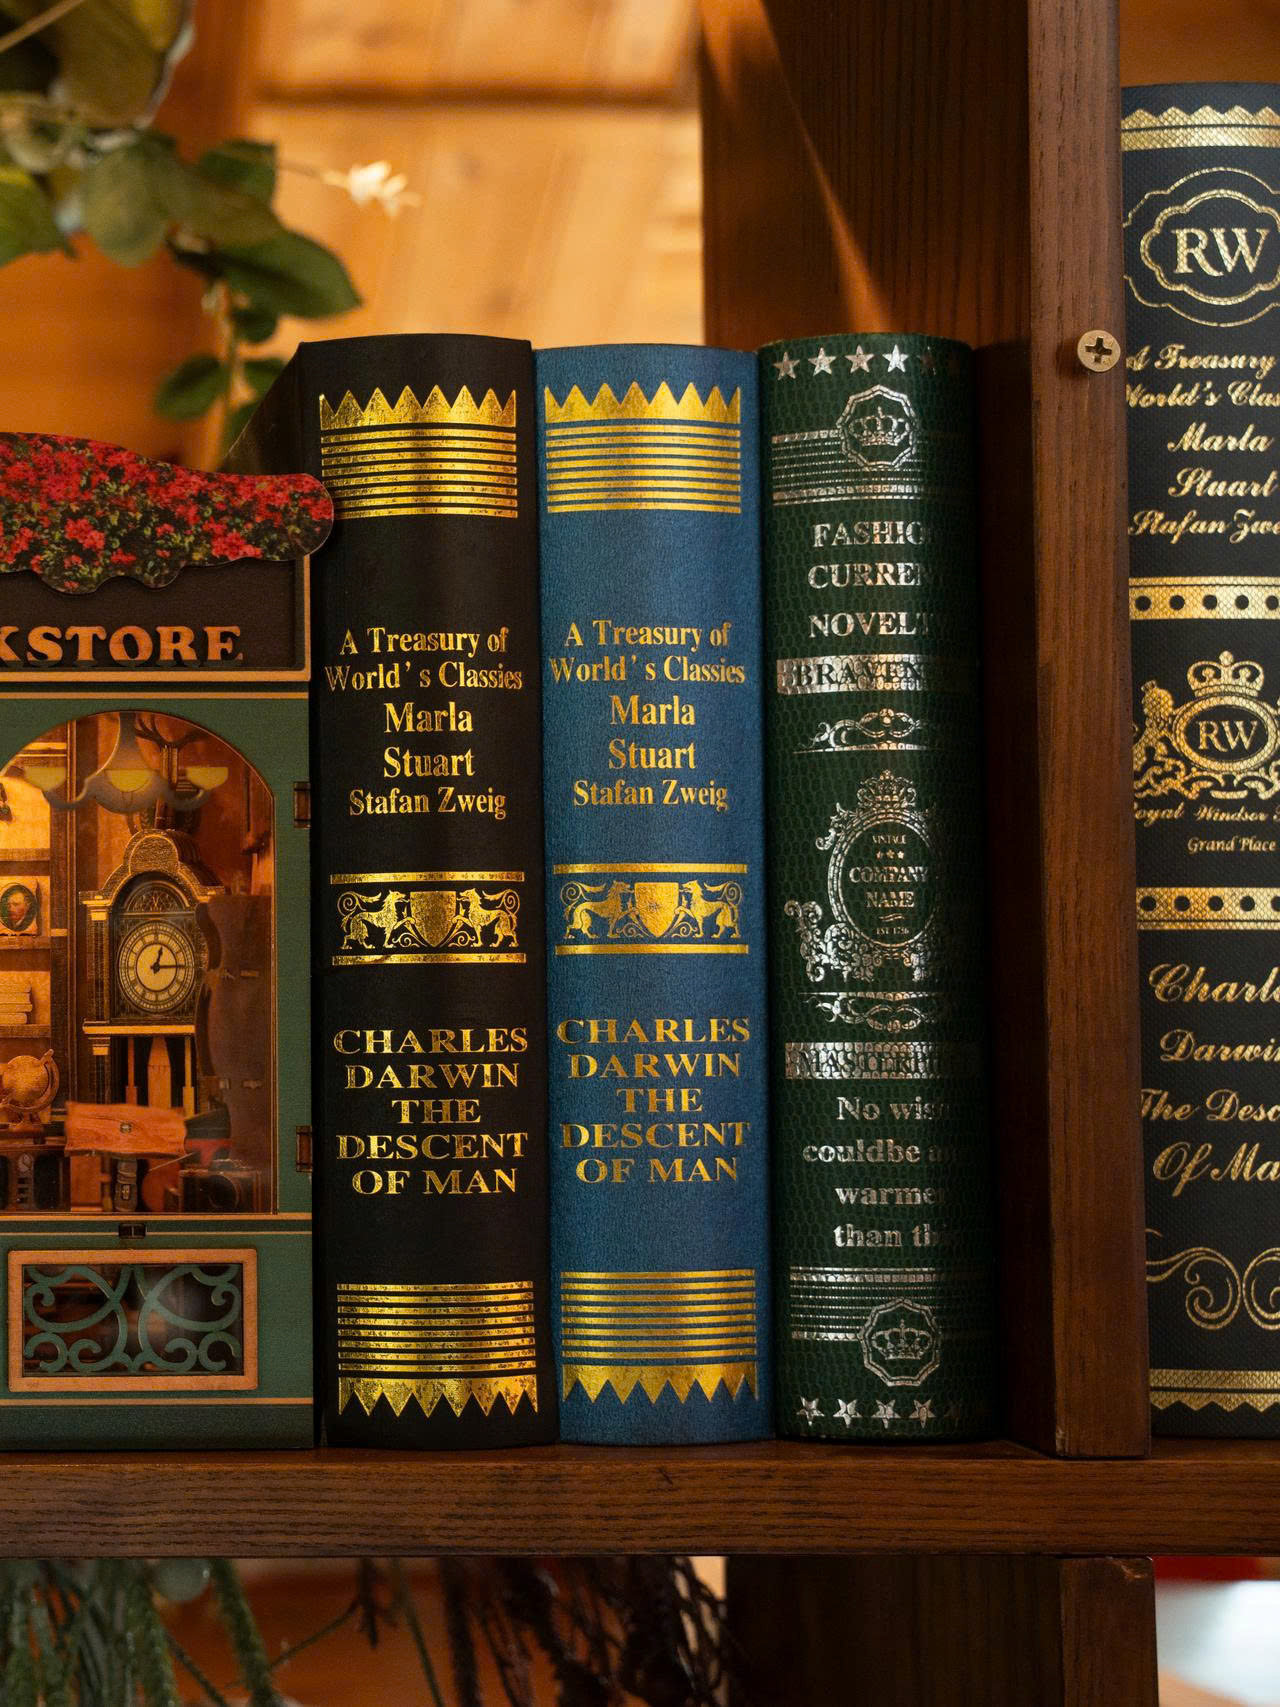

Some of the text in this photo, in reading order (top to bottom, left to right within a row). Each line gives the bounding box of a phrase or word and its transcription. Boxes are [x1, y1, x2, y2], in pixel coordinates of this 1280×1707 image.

[1172, 227, 1270, 277] RW
[1155, 343, 1277, 379] Treasury
[1167, 422, 1274, 452] Marla
[1168, 467, 1278, 497] Stuart
[339, 626, 510, 658] A Treasury of
[564, 619, 732, 652] A Treasury of
[384, 701, 474, 733] Marla
[609, 694, 696, 726] Marla
[1195, 720, 1259, 752] RW
[383, 746, 475, 778] Stuart
[608, 738, 697, 770] Stuart
[349, 786, 506, 820] Stafan Zweig
[573, 779, 729, 812] Stafan Zweig
[1187, 835, 1277, 854] Grand Place
[849, 866, 929, 883] COMPANY
[866, 891, 915, 908] NAME
[333, 1027, 528, 1055] CHARLES
[556, 1016, 751, 1044] CHARLES
[1160, 1028, 1280, 1061] Darwi
[344, 1063, 520, 1089] DARWIN
[567, 1052, 741, 1079] DARWIN
[391, 1099, 481, 1124] THE
[616, 1087, 703, 1113] THE
[836, 1096, 880, 1121] No
[335, 1132, 528, 1160] DESCENT
[559, 1122, 751, 1148] DESCENT
[352, 1168, 518, 1195] OF MAN
[575, 1157, 737, 1184] OF MAN
[1152, 1141, 1212, 1197] Of
[833, 1223, 902, 1248] than
